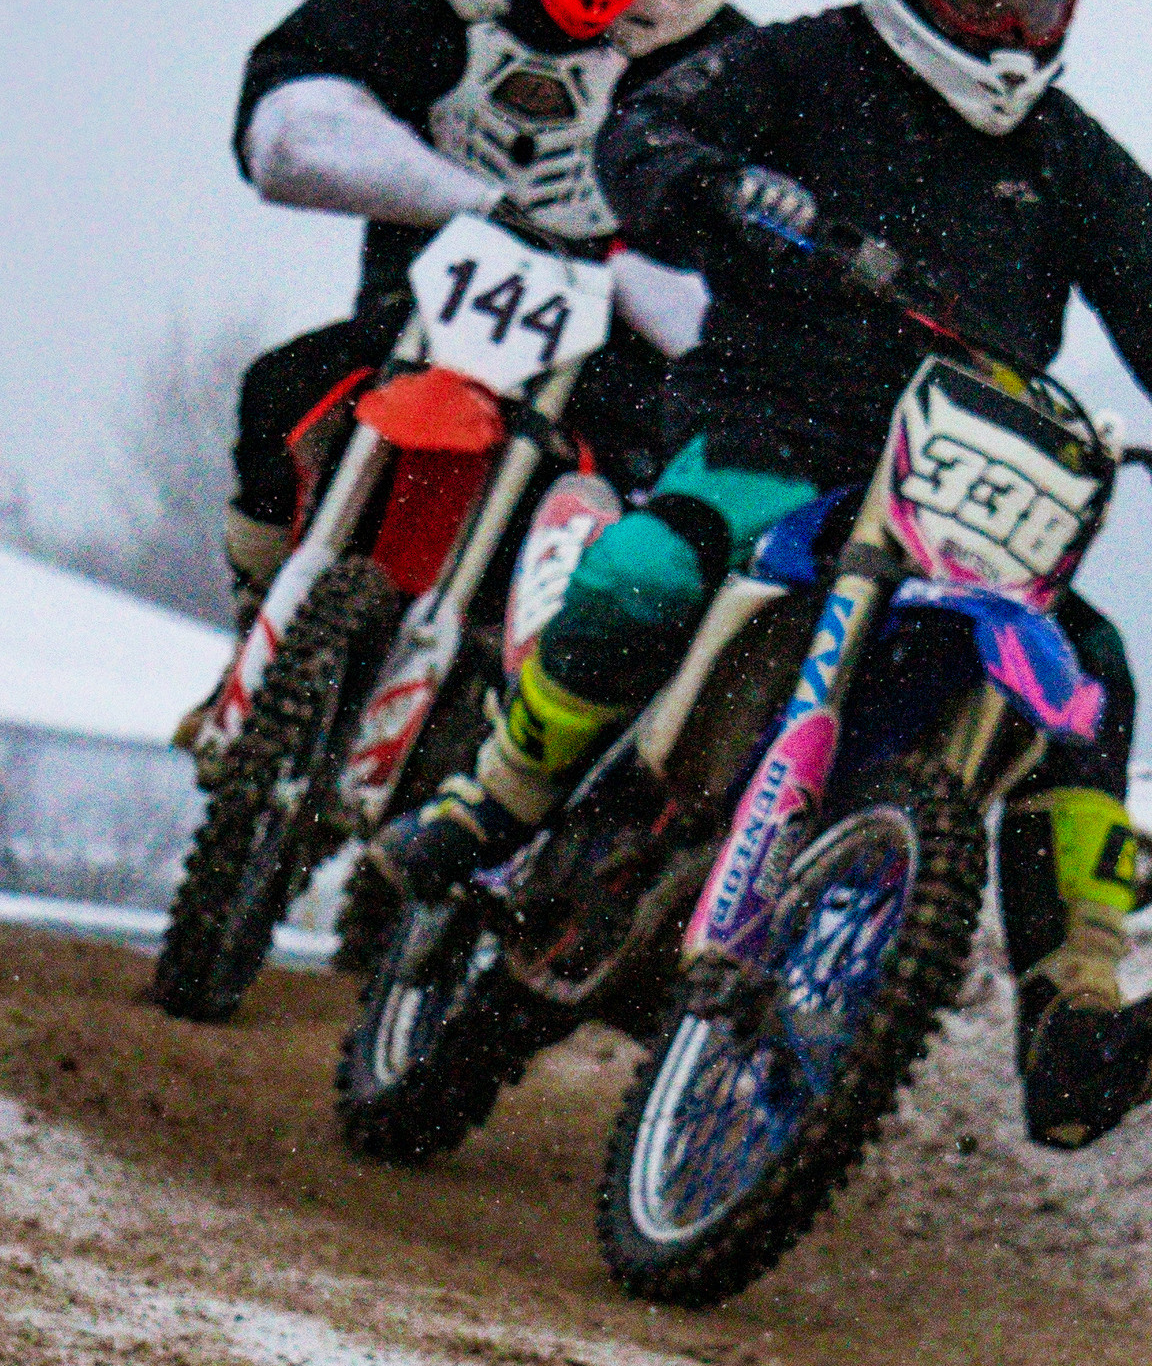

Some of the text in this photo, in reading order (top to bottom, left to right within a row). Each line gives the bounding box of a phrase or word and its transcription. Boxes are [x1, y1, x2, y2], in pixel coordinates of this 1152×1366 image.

[439, 257, 571, 363] 144
[900, 432, 1083, 578] 338
[712, 759, 789, 926] DUNLOP
